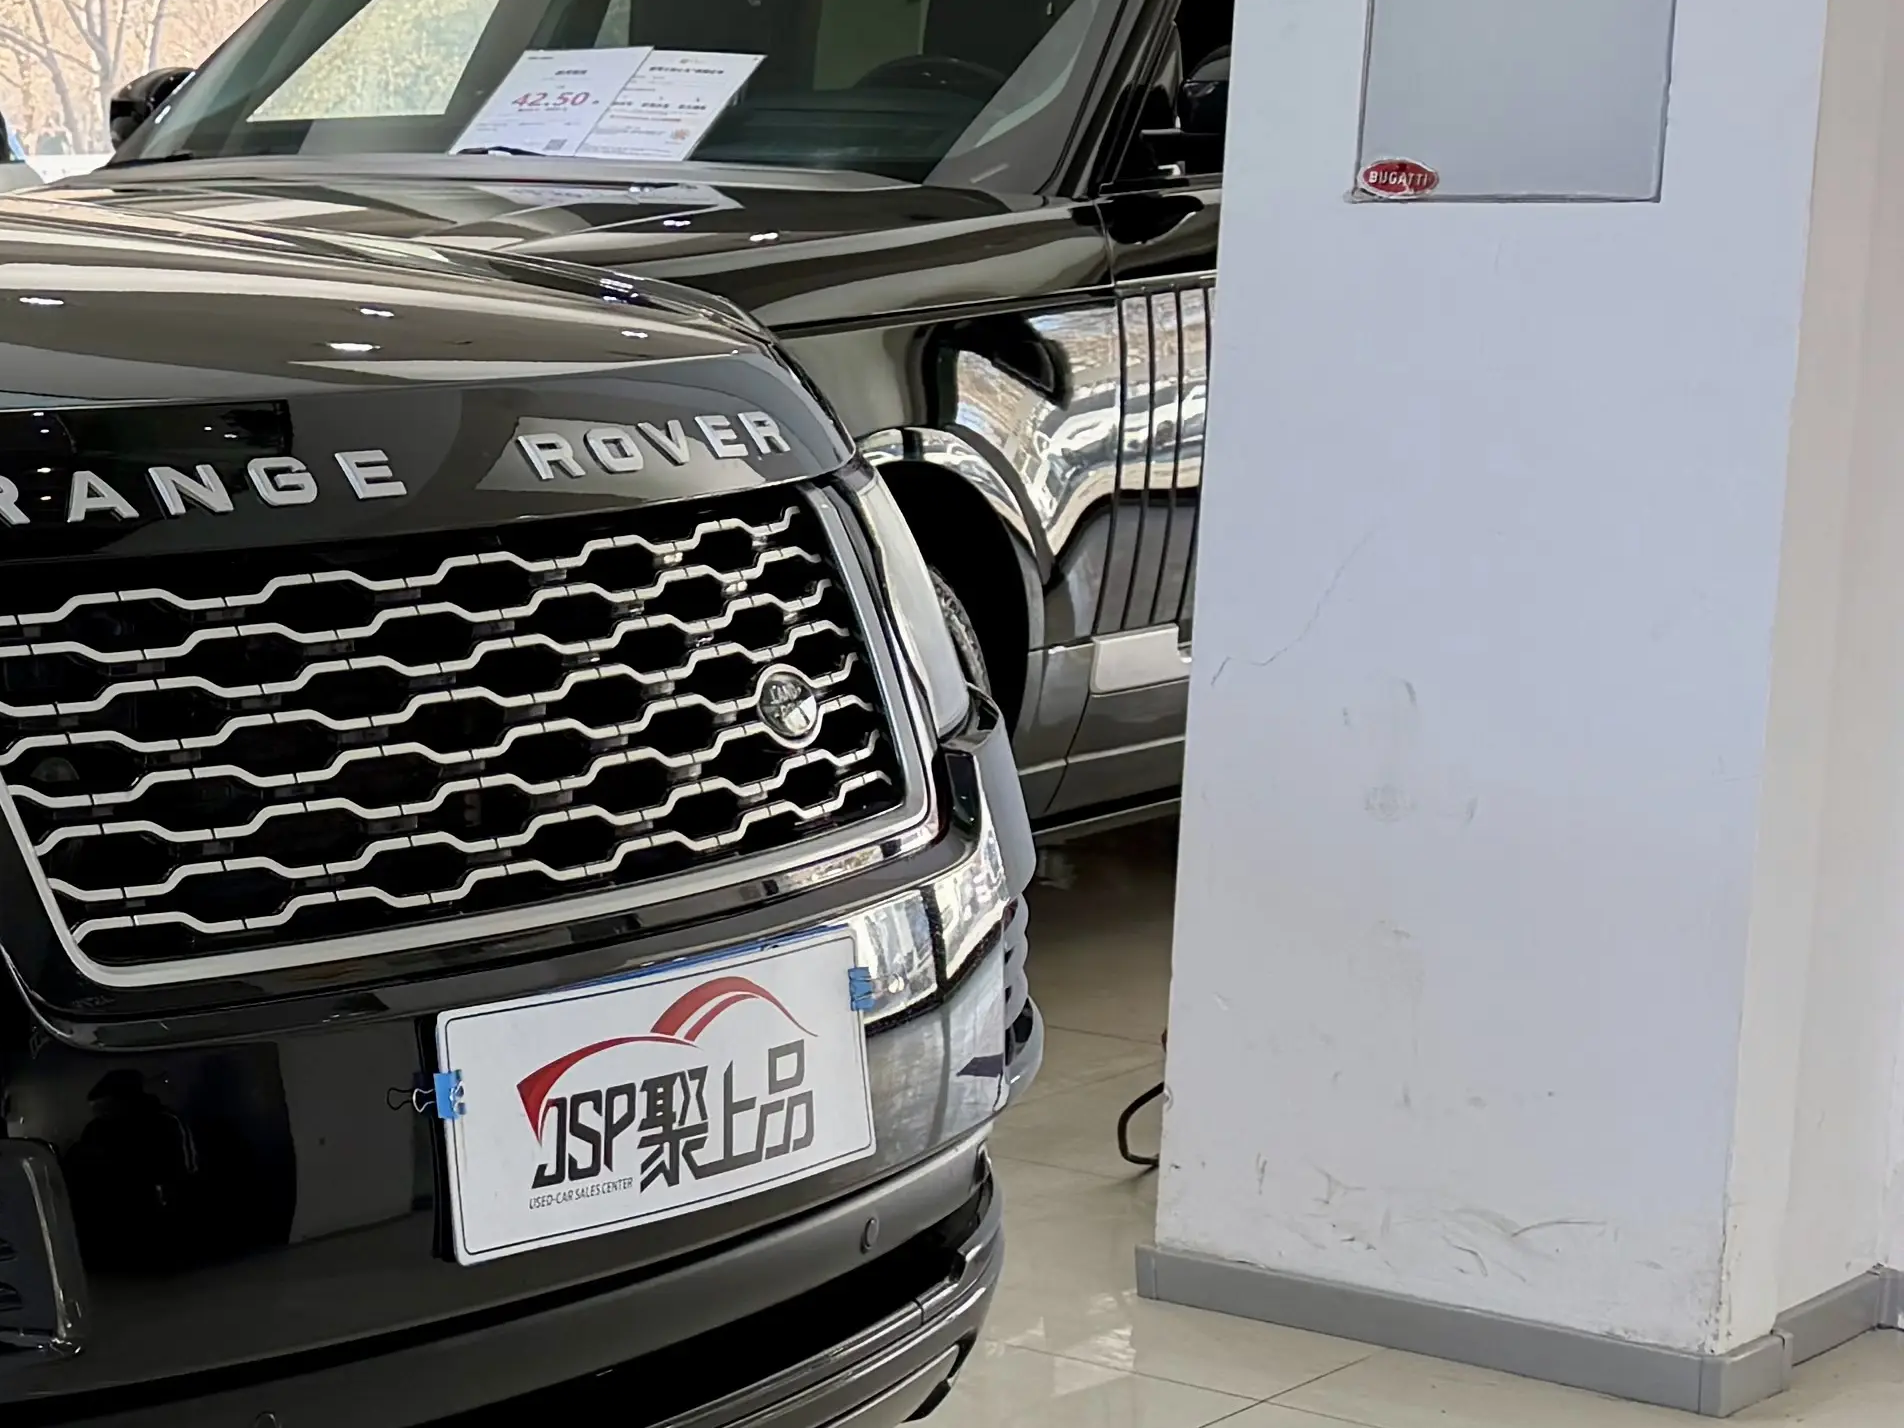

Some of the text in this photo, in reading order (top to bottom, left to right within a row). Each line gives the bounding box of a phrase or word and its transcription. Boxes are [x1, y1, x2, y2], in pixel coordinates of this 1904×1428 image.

[511, 91, 591, 107] 42.50
[1368, 171, 1428, 185] BUGATTI
[517, 410, 792, 481] ROVER
[529, 1176, 633, 1210] USED-CAR SALES CENTER
